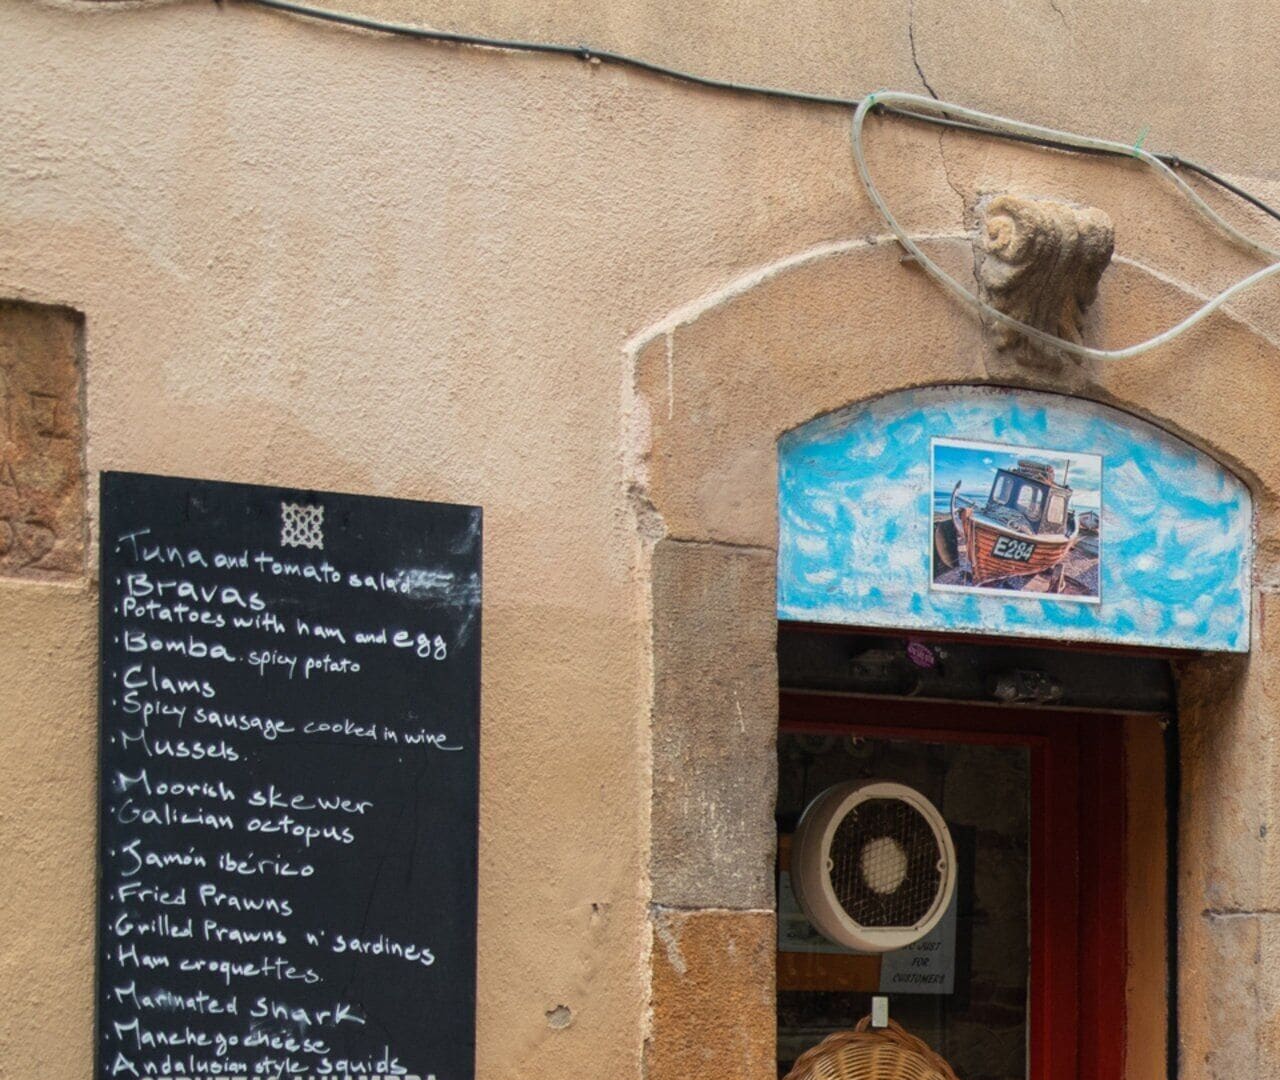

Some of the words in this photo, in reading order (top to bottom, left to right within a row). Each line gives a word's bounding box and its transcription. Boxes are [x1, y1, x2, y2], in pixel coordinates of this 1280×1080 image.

[118, 528, 207, 568] Tuna
[215, 547, 248, 568] and
[255, 551, 341, 584] tomato
[349, 570, 411, 593] salad
[993, 536, 1034, 561] E284
[127, 573, 266, 611] Bravas
[123, 597, 226, 627] Potatoes
[234, 614, 286, 634] with
[297, 618, 346, 644] ham
[355, 629, 388, 645] and
[393, 630, 447, 660] egg
[123, 631, 235, 662] Bomba
[248, 649, 298, 679] spicy
[305, 655, 361, 679] potato
[123, 665, 216, 697] Clams
[123, 691, 187, 728] Spicy
[195, 705, 296, 741] sausage
[304, 717, 377, 740] cooked
[383, 725, 399, 743] in
[404, 731, 464, 751] wine
[248, 785, 374, 814] skewer
[118, 799, 234, 830] Galician
[247, 815, 355, 847] octopus
[121, 840, 207, 877] Jamón
[219, 852, 314, 877] ibérico
[119, 881, 186, 905] Fried
[199, 884, 293, 916] Prawns
[114, 914, 193, 938] Grilled
[204, 923, 287, 945] Prawns
[333, 933, 435, 966] sardines
[118, 945, 170, 969] Ham
[114, 980, 238, 1015] Marinated
[250, 996, 366, 1025] Shark
[113, 1018, 239, 1056] Manchego
[254, 1055, 309, 1080] style
[317, 1045, 407, 1080] squids
